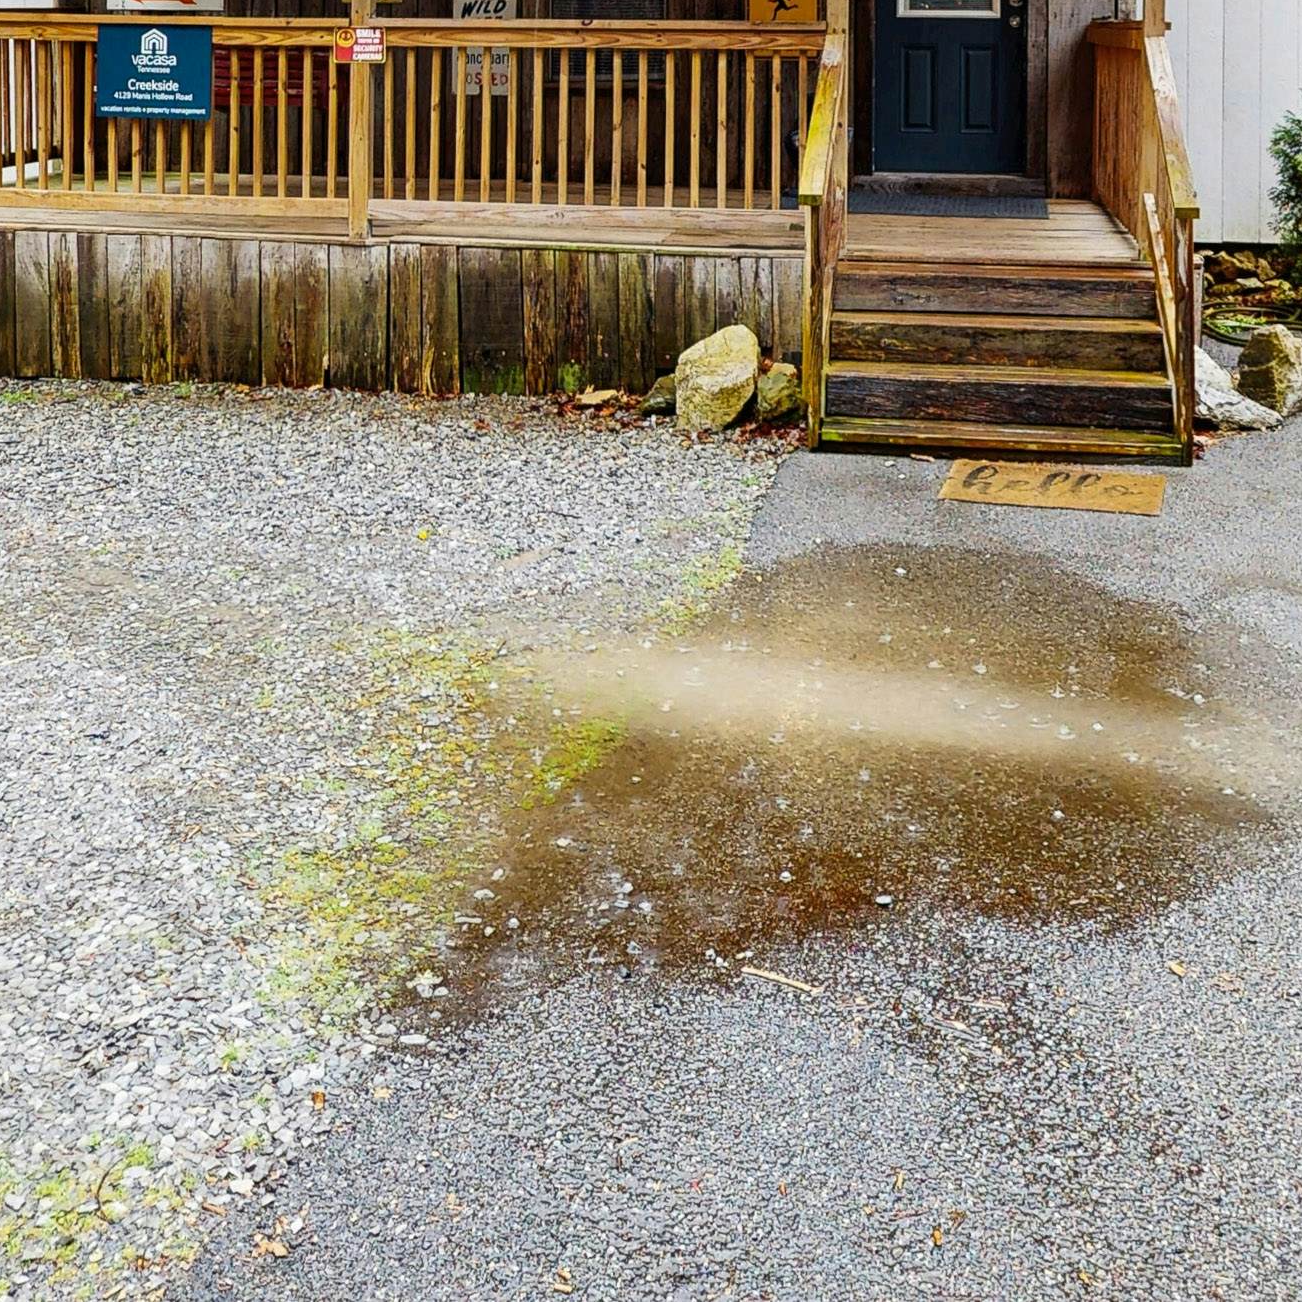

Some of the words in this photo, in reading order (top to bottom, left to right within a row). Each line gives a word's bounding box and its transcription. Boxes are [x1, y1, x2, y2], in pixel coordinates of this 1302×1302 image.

[461, 0, 507, 19] WILD
[356, 29, 381, 38] SMILE
[353, 45, 383, 53] SECURITY
[131, 54, 177, 66] vacasa
[138, 66, 170, 74] Tennessee
[127, 78, 180, 91] Creekside
[114, 91, 131, 100] 4129
[152, 92, 175, 101] Hollow
[176, 93, 194, 101] Road
[171, 107, 206, 115] management
[962, 464, 1144, 497] hello
